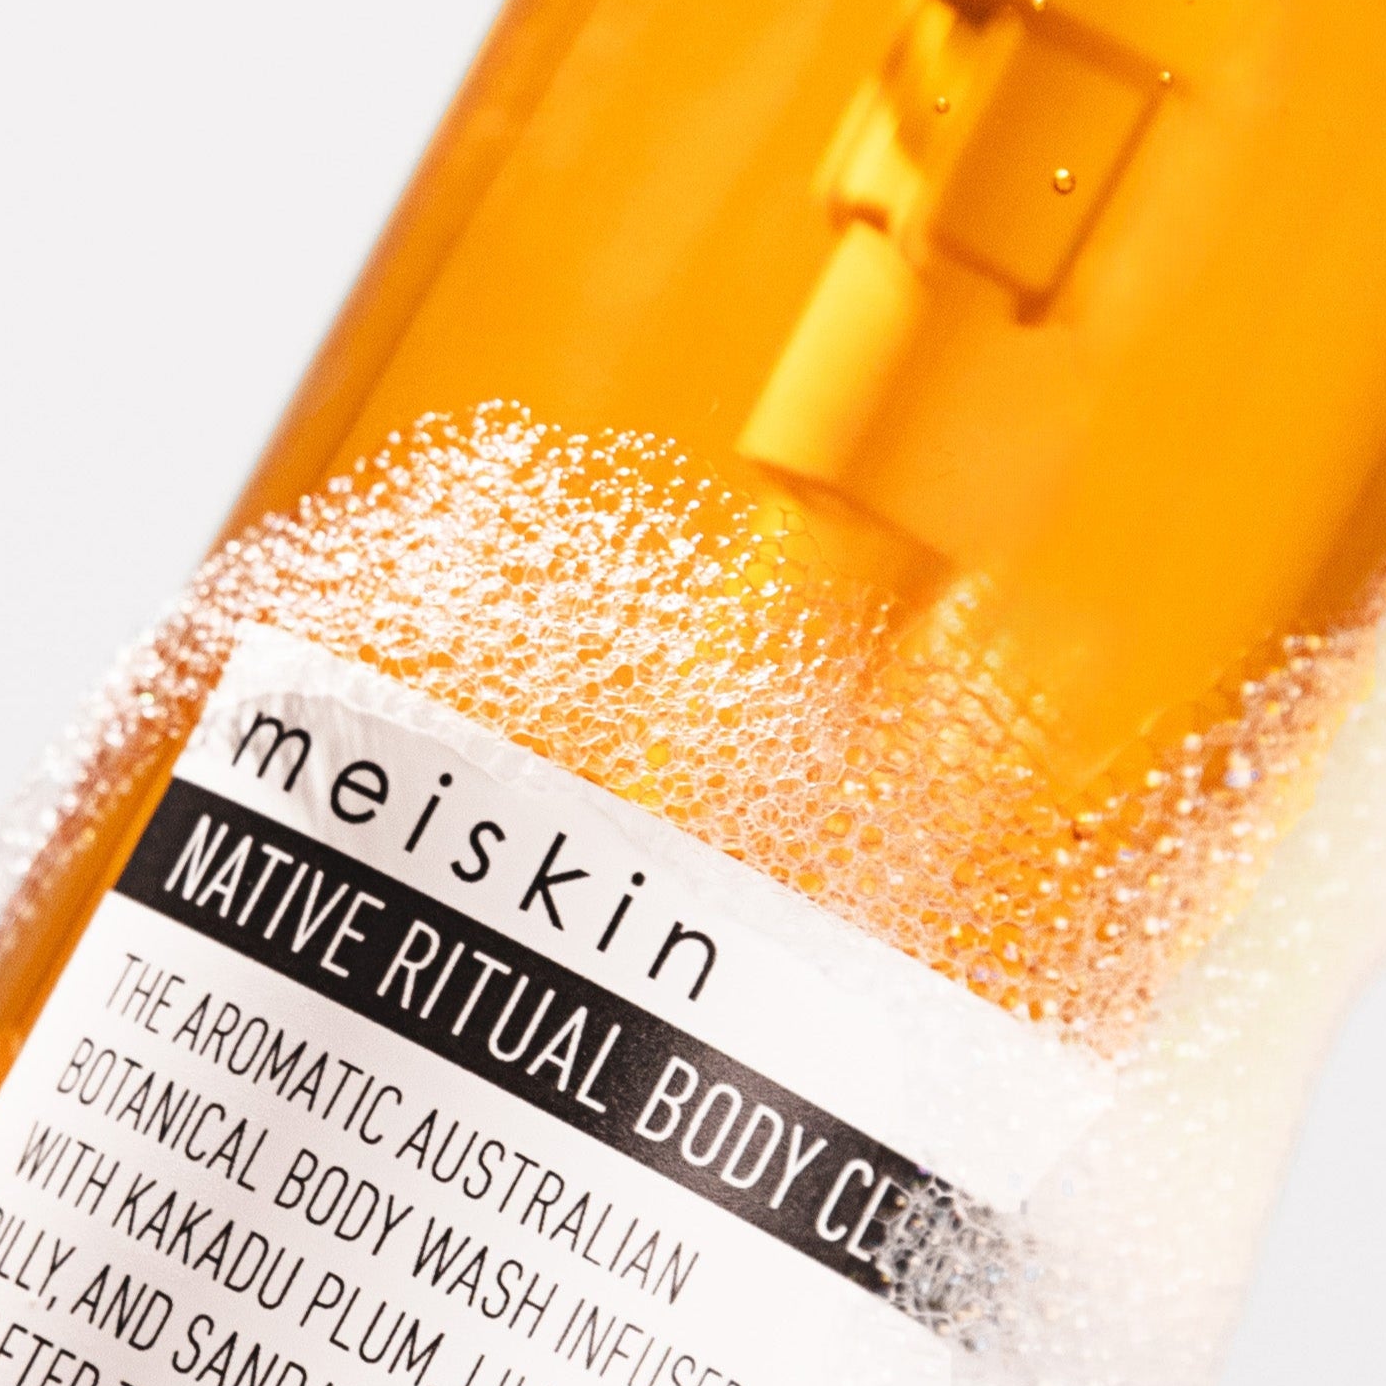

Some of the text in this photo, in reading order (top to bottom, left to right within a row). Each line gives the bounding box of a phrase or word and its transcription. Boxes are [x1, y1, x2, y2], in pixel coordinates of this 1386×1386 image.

[230, 709, 719, 1003] meiskin
[103, 951, 700, 1306] THE AROMATIC AUSTRALIAN
[163, 814, 386, 978] NATIVE
[376, 919, 622, 1114] RITUAL
[632, 1054, 829, 1211] BODY
[15, 1126, 122, 1217] WITH
[110, 1171, 306, 1312] KAKADU
[55, 1036, 270, 1194] BOTANICAL
[271, 1146, 416, 1258] BODY
[410, 1215, 560, 1340] WASH
[68, 1262, 176, 1353] AND
